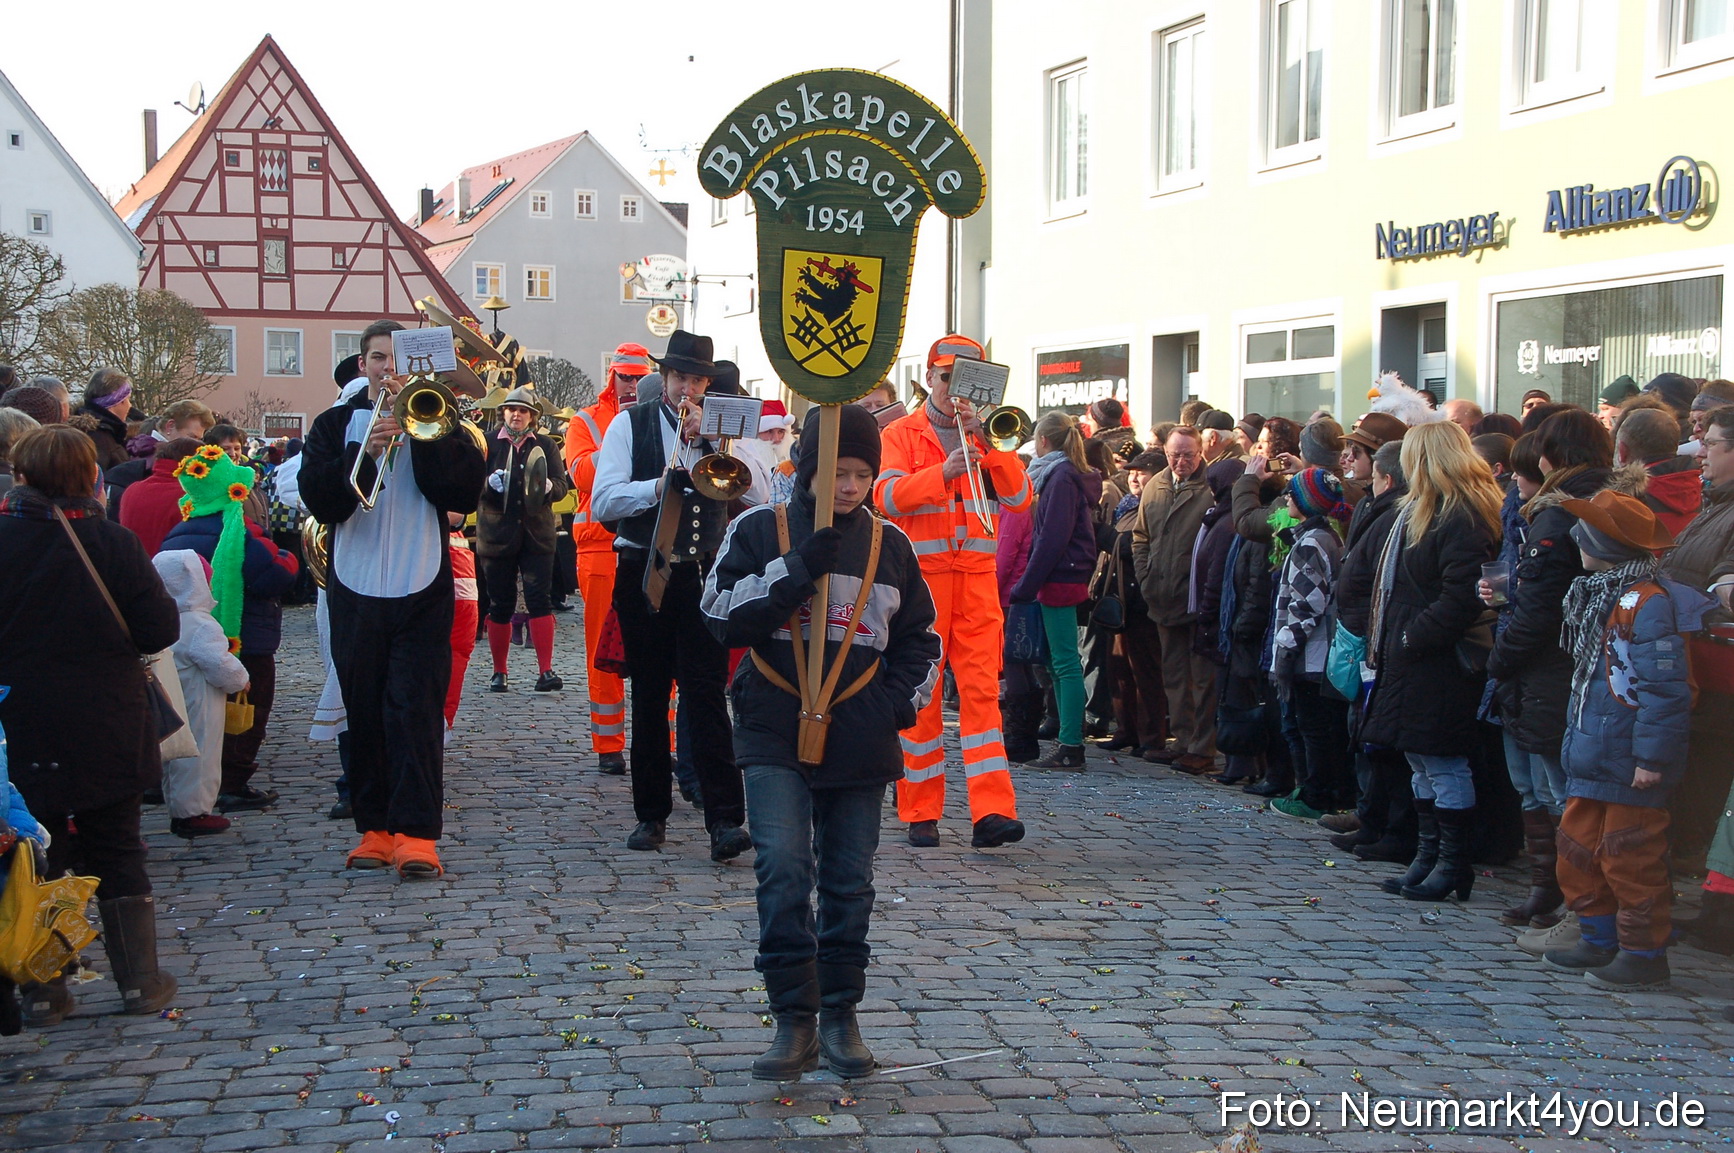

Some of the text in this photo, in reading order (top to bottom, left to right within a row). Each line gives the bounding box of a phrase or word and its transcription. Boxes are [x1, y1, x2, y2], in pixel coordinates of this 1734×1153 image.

[703, 83, 962, 194] Blaskapelle
[752, 147, 916, 226] Pilsach
[806, 205, 865, 236] 1954
[1543, 183, 1654, 233] Allianz
[1375, 211, 1500, 260] Neumeyer
[1544, 344, 1601, 367] Neumeyer
[1646, 335, 1698, 358] Allianz
[1039, 379, 1114, 407] HOFBAUER
